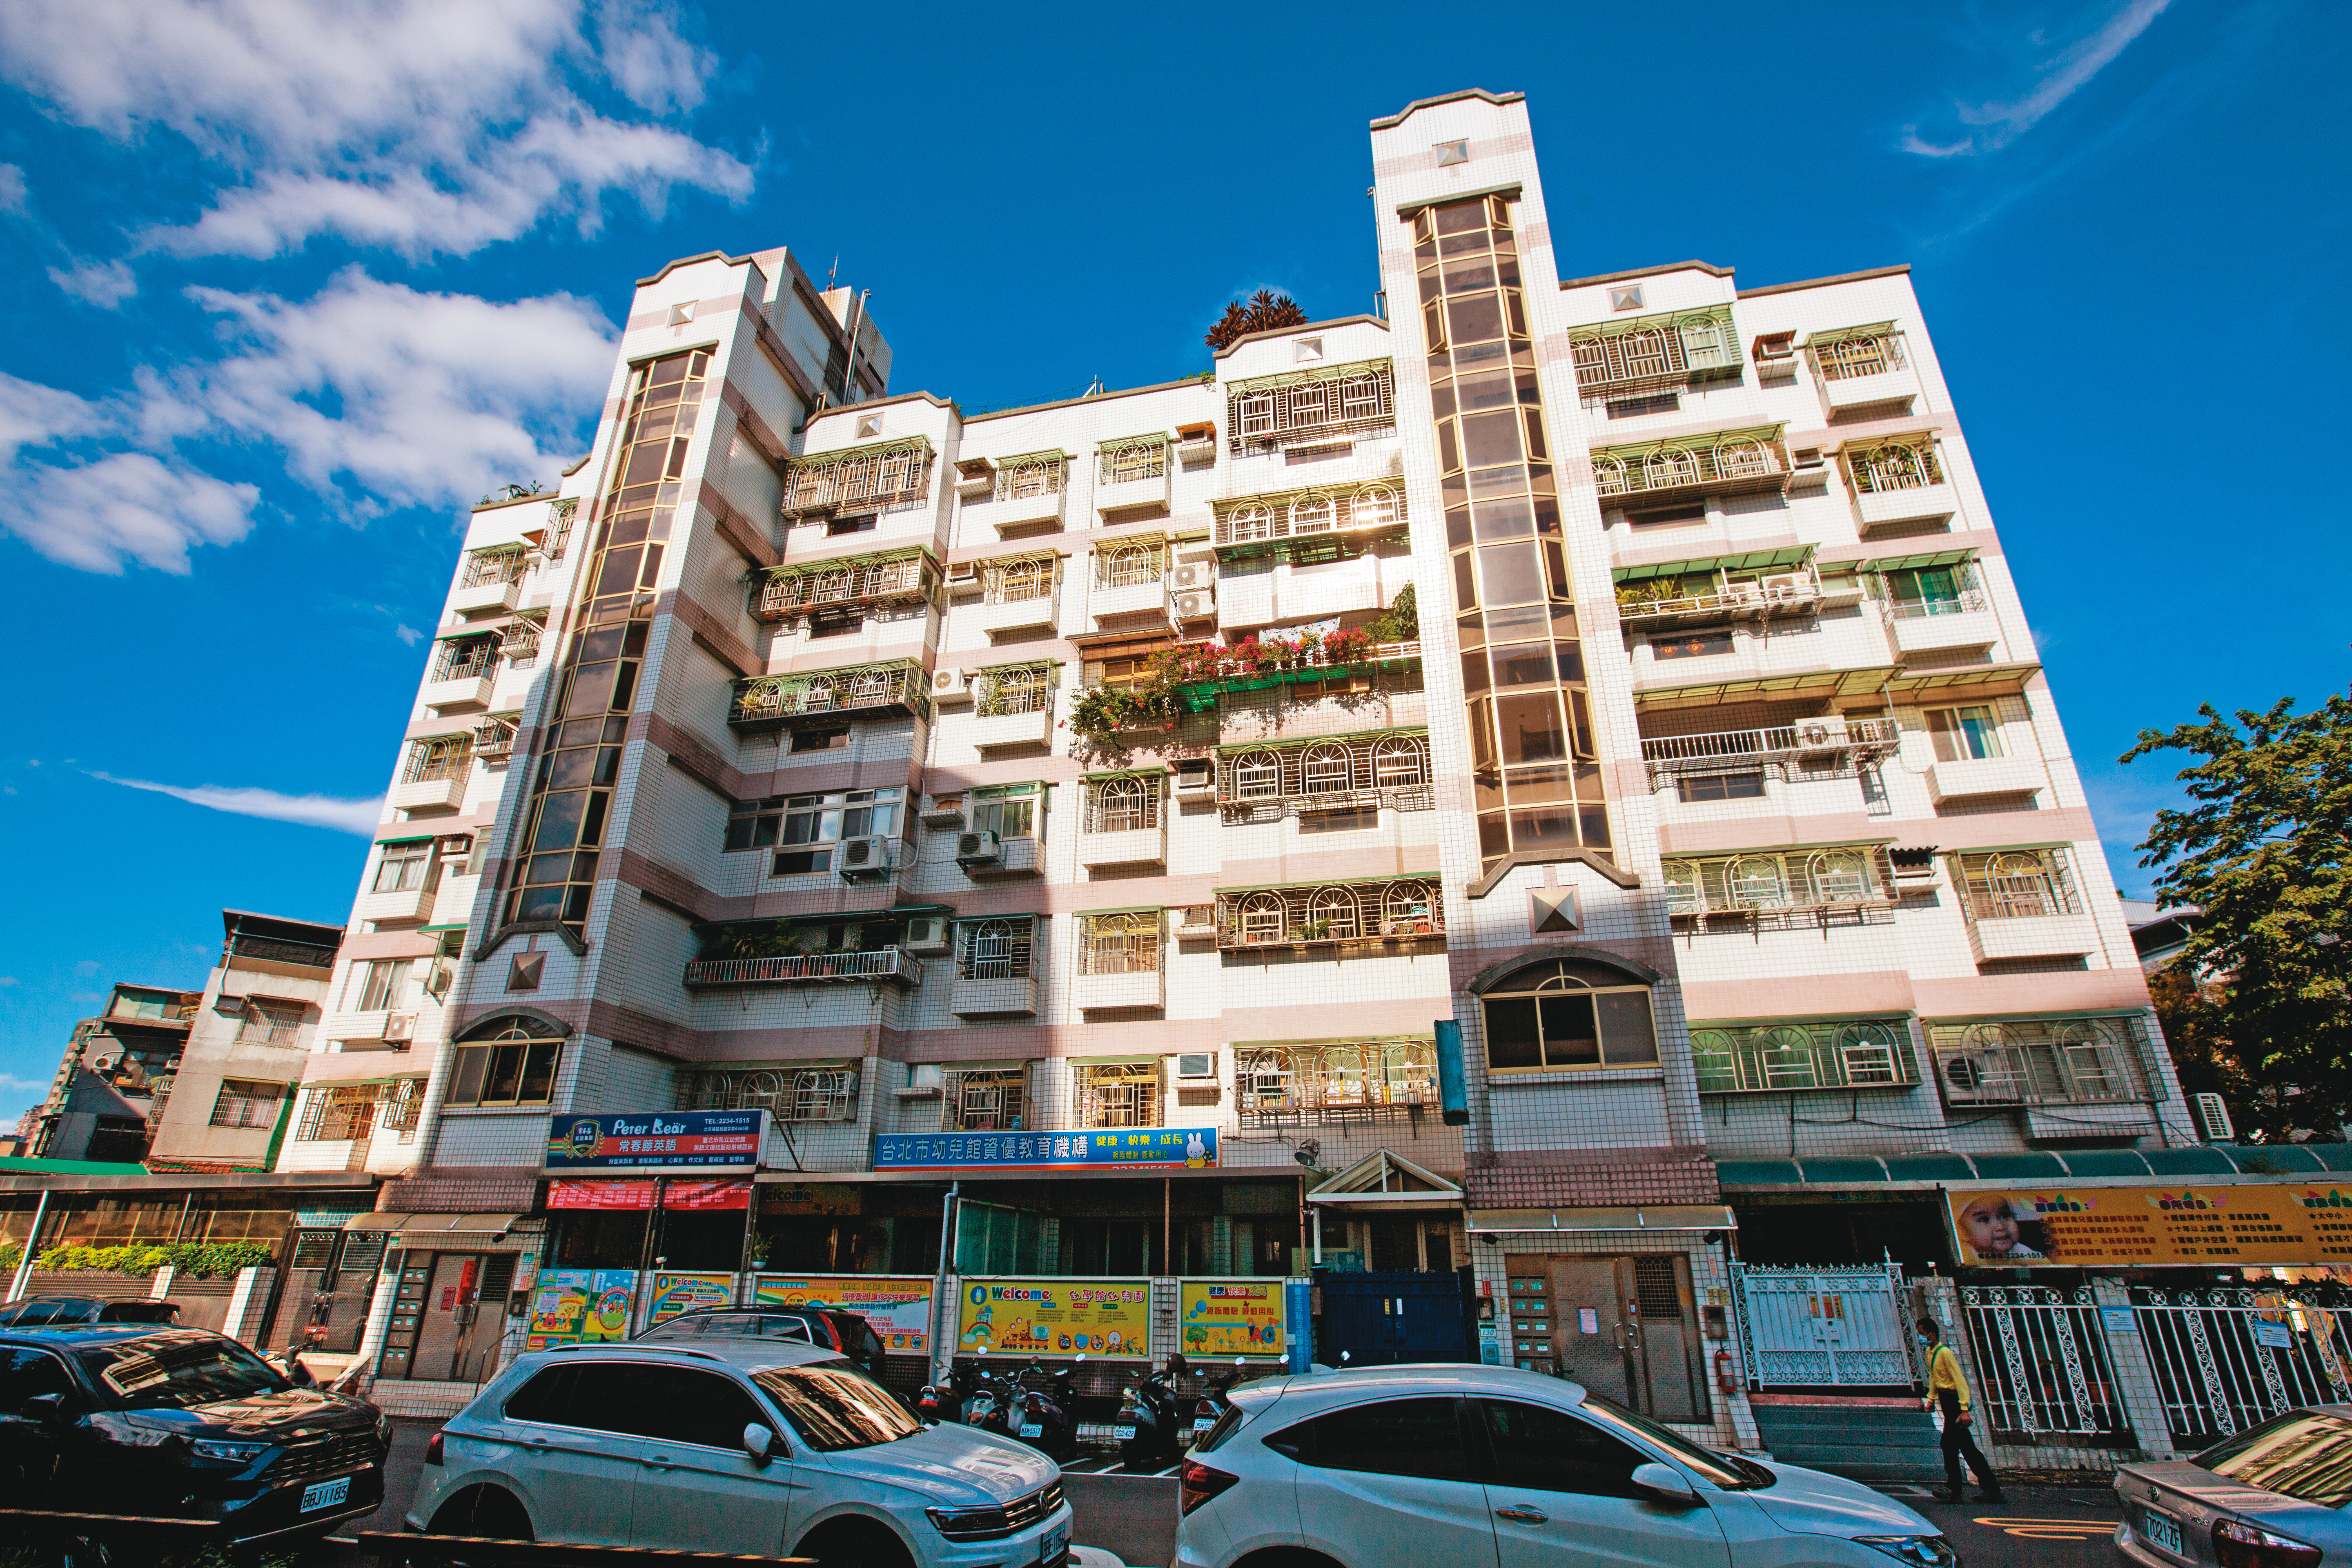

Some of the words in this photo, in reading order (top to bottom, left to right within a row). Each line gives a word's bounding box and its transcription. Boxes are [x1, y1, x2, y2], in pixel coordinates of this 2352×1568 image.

[612, 1119, 649, 1135] Peter
[652, 1118, 686, 1134] Bear
[619, 1138, 677, 1152] 常春藤英語
[1096, 1135, 1118, 1146] 健康
[1128, 1134, 1150, 1146] 快樂
[1161, 1134, 1183, 1145] 成長
[882, 1135, 1088, 1161] 台北市幼兒館資優教育機構
[1112, 1150, 1139, 1160] 親臨體驗
[1142, 1150, 1168, 1159] 感動用心
[670, 1277, 703, 1286] Welcome
[841, 1292, 869, 1301] 打穩基礎
[871, 1292, 920, 1302] 讓孩子快樂學習
[991, 1286, 1051, 1301] Welcome
[1069, 1289, 1145, 1303] 幼學館幼兒園
[1209, 1286, 1225, 1295] 健康
[1228, 1286, 1245, 1295] 快樂
[1249, 1286, 1267, 1296] 成長
[1207, 1307, 1238, 1315] 親臨體驗
[1242, 1307, 1274, 1315] 感動用心
[1294, 1287, 1304, 1374] 臺北市私立幼學館幼兒
[302, 1484, 347, 1508] BBJ-1183
[2147, 1515, 2179, 1548] 7021-ZF
